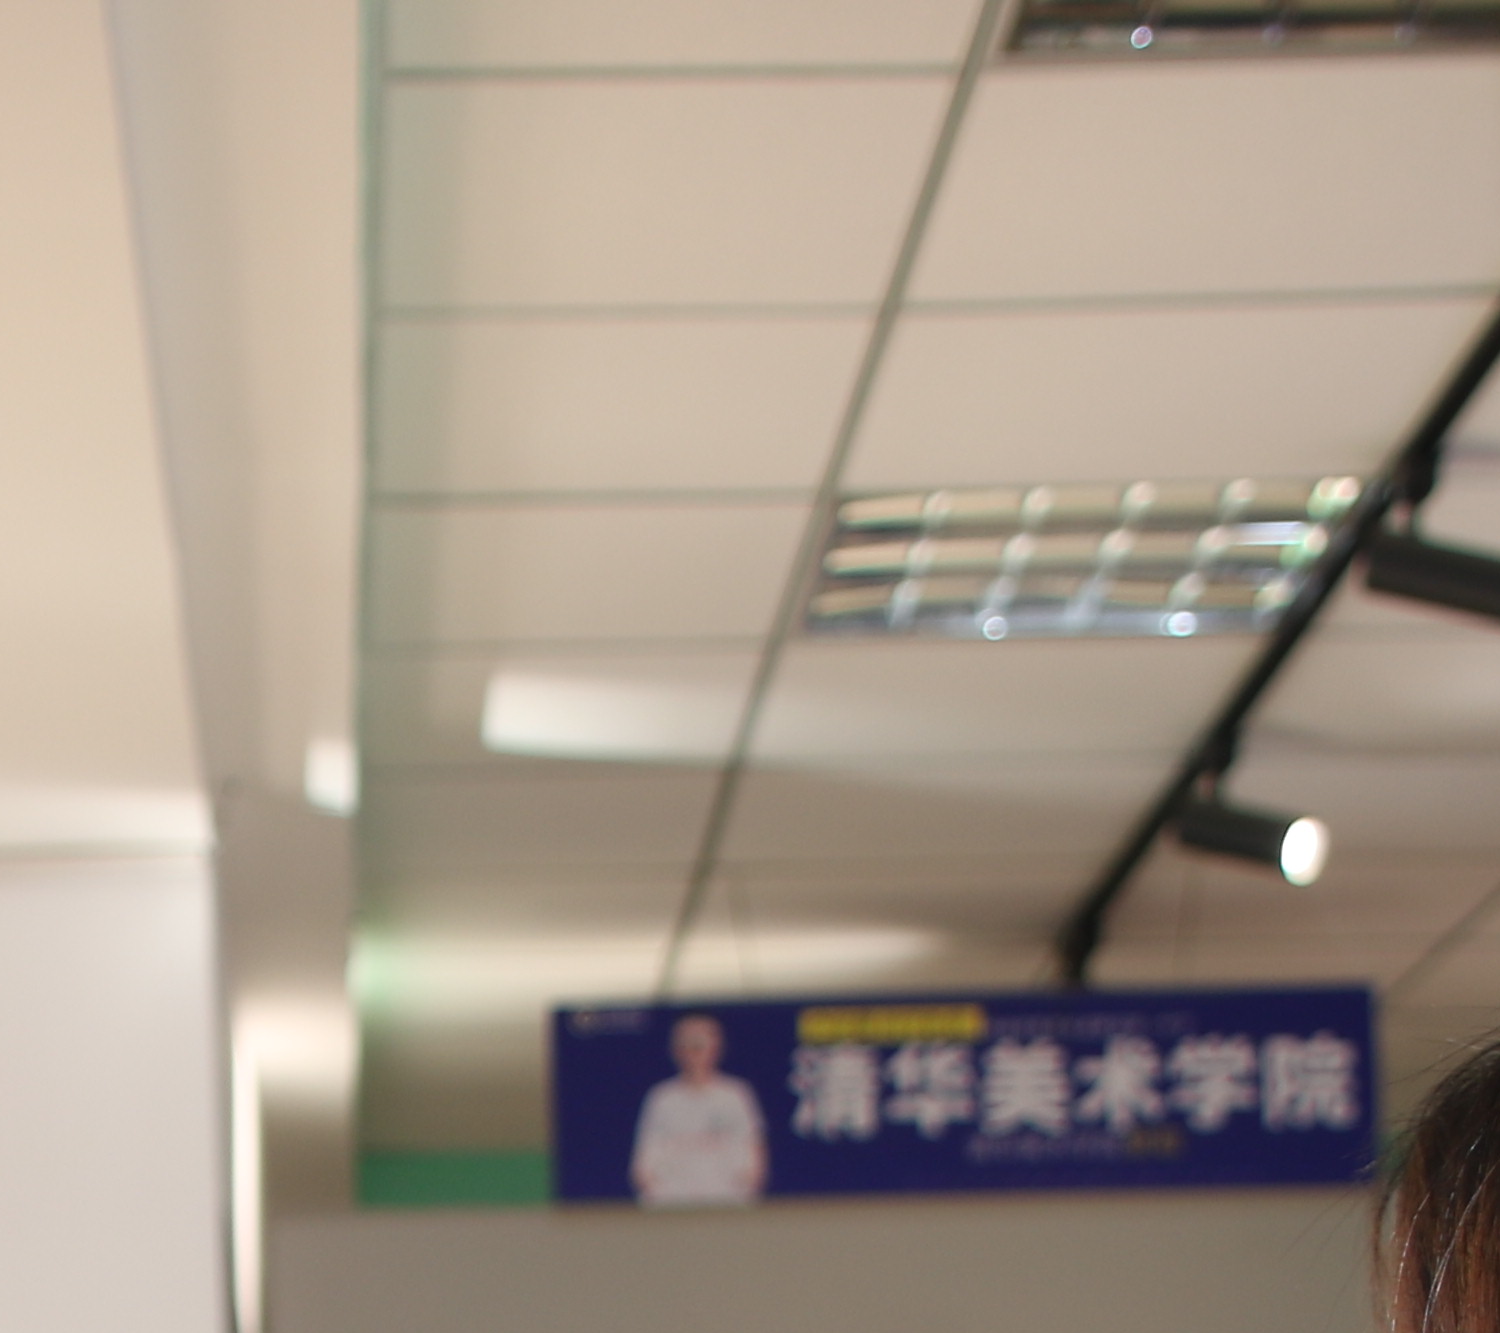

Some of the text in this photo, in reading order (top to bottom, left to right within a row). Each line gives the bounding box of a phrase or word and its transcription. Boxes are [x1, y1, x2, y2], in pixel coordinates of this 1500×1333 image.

[789, 1031, 1359, 1140] 清华美术学院
